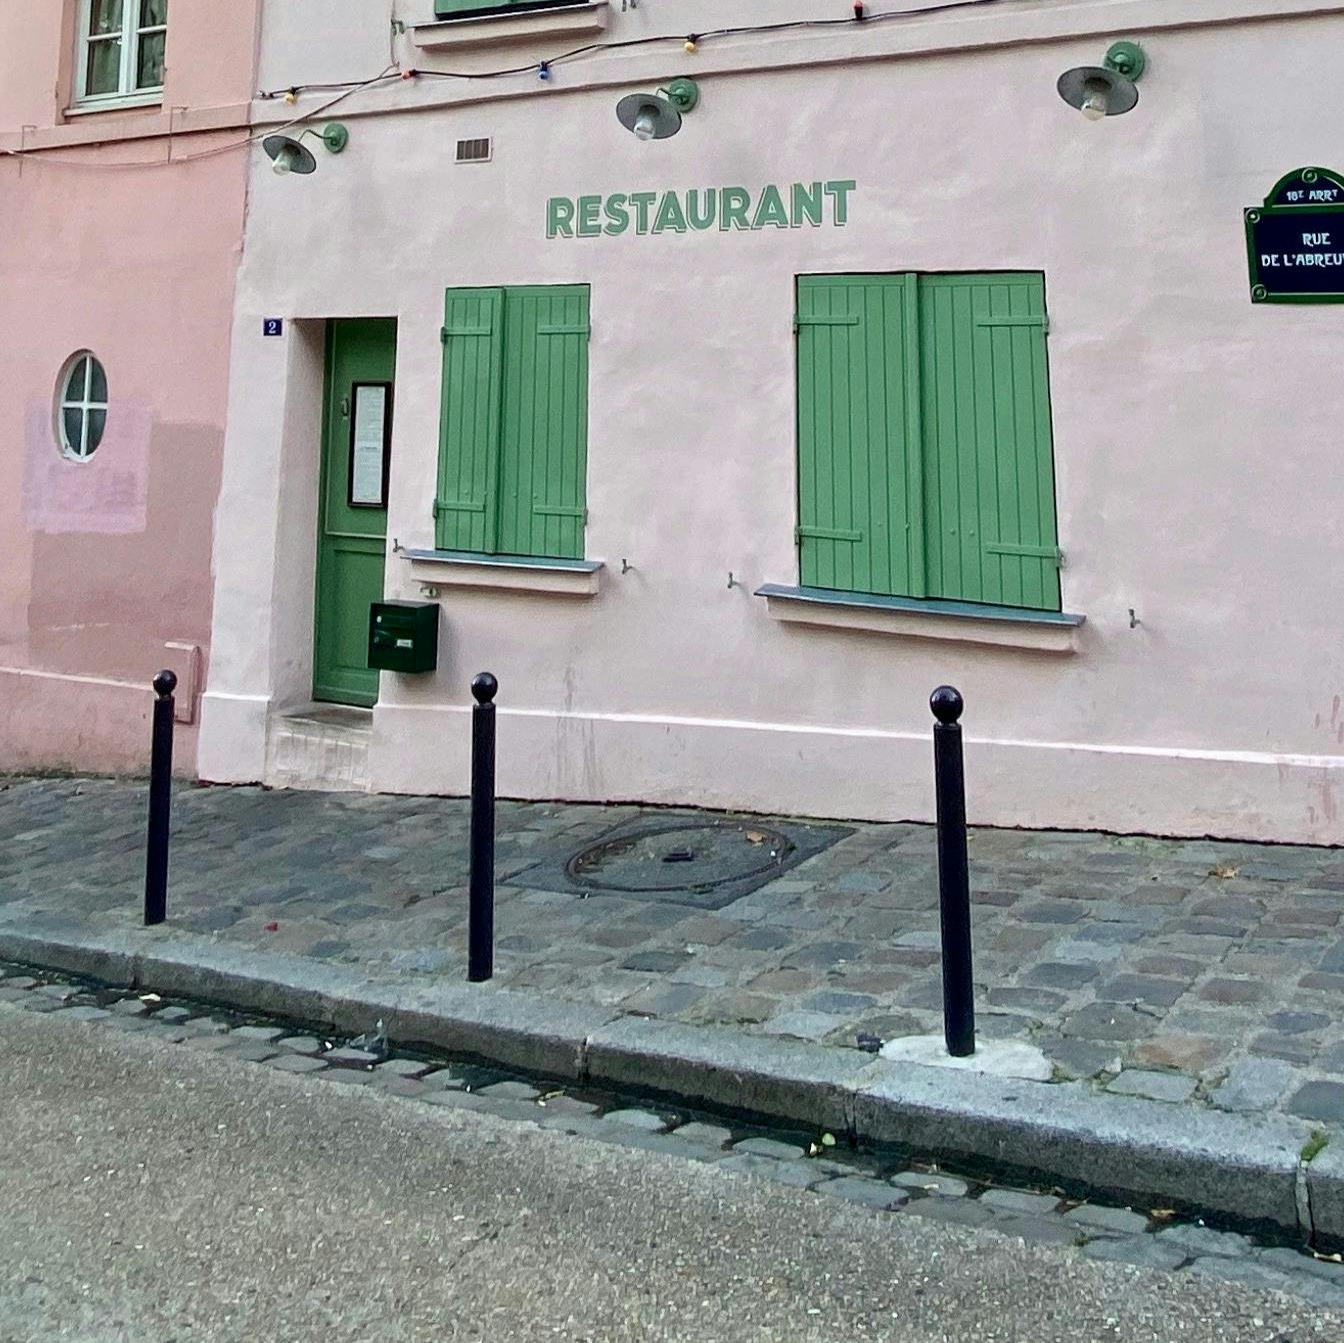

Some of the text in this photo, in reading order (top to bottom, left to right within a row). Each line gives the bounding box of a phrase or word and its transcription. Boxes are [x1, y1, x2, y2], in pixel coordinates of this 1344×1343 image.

[545, 179, 856, 239] RESTAURANT
[1302, 233, 1331, 247] RUE
[1261, 254, 1280, 267] DE
[268, 320, 277, 334] 2
